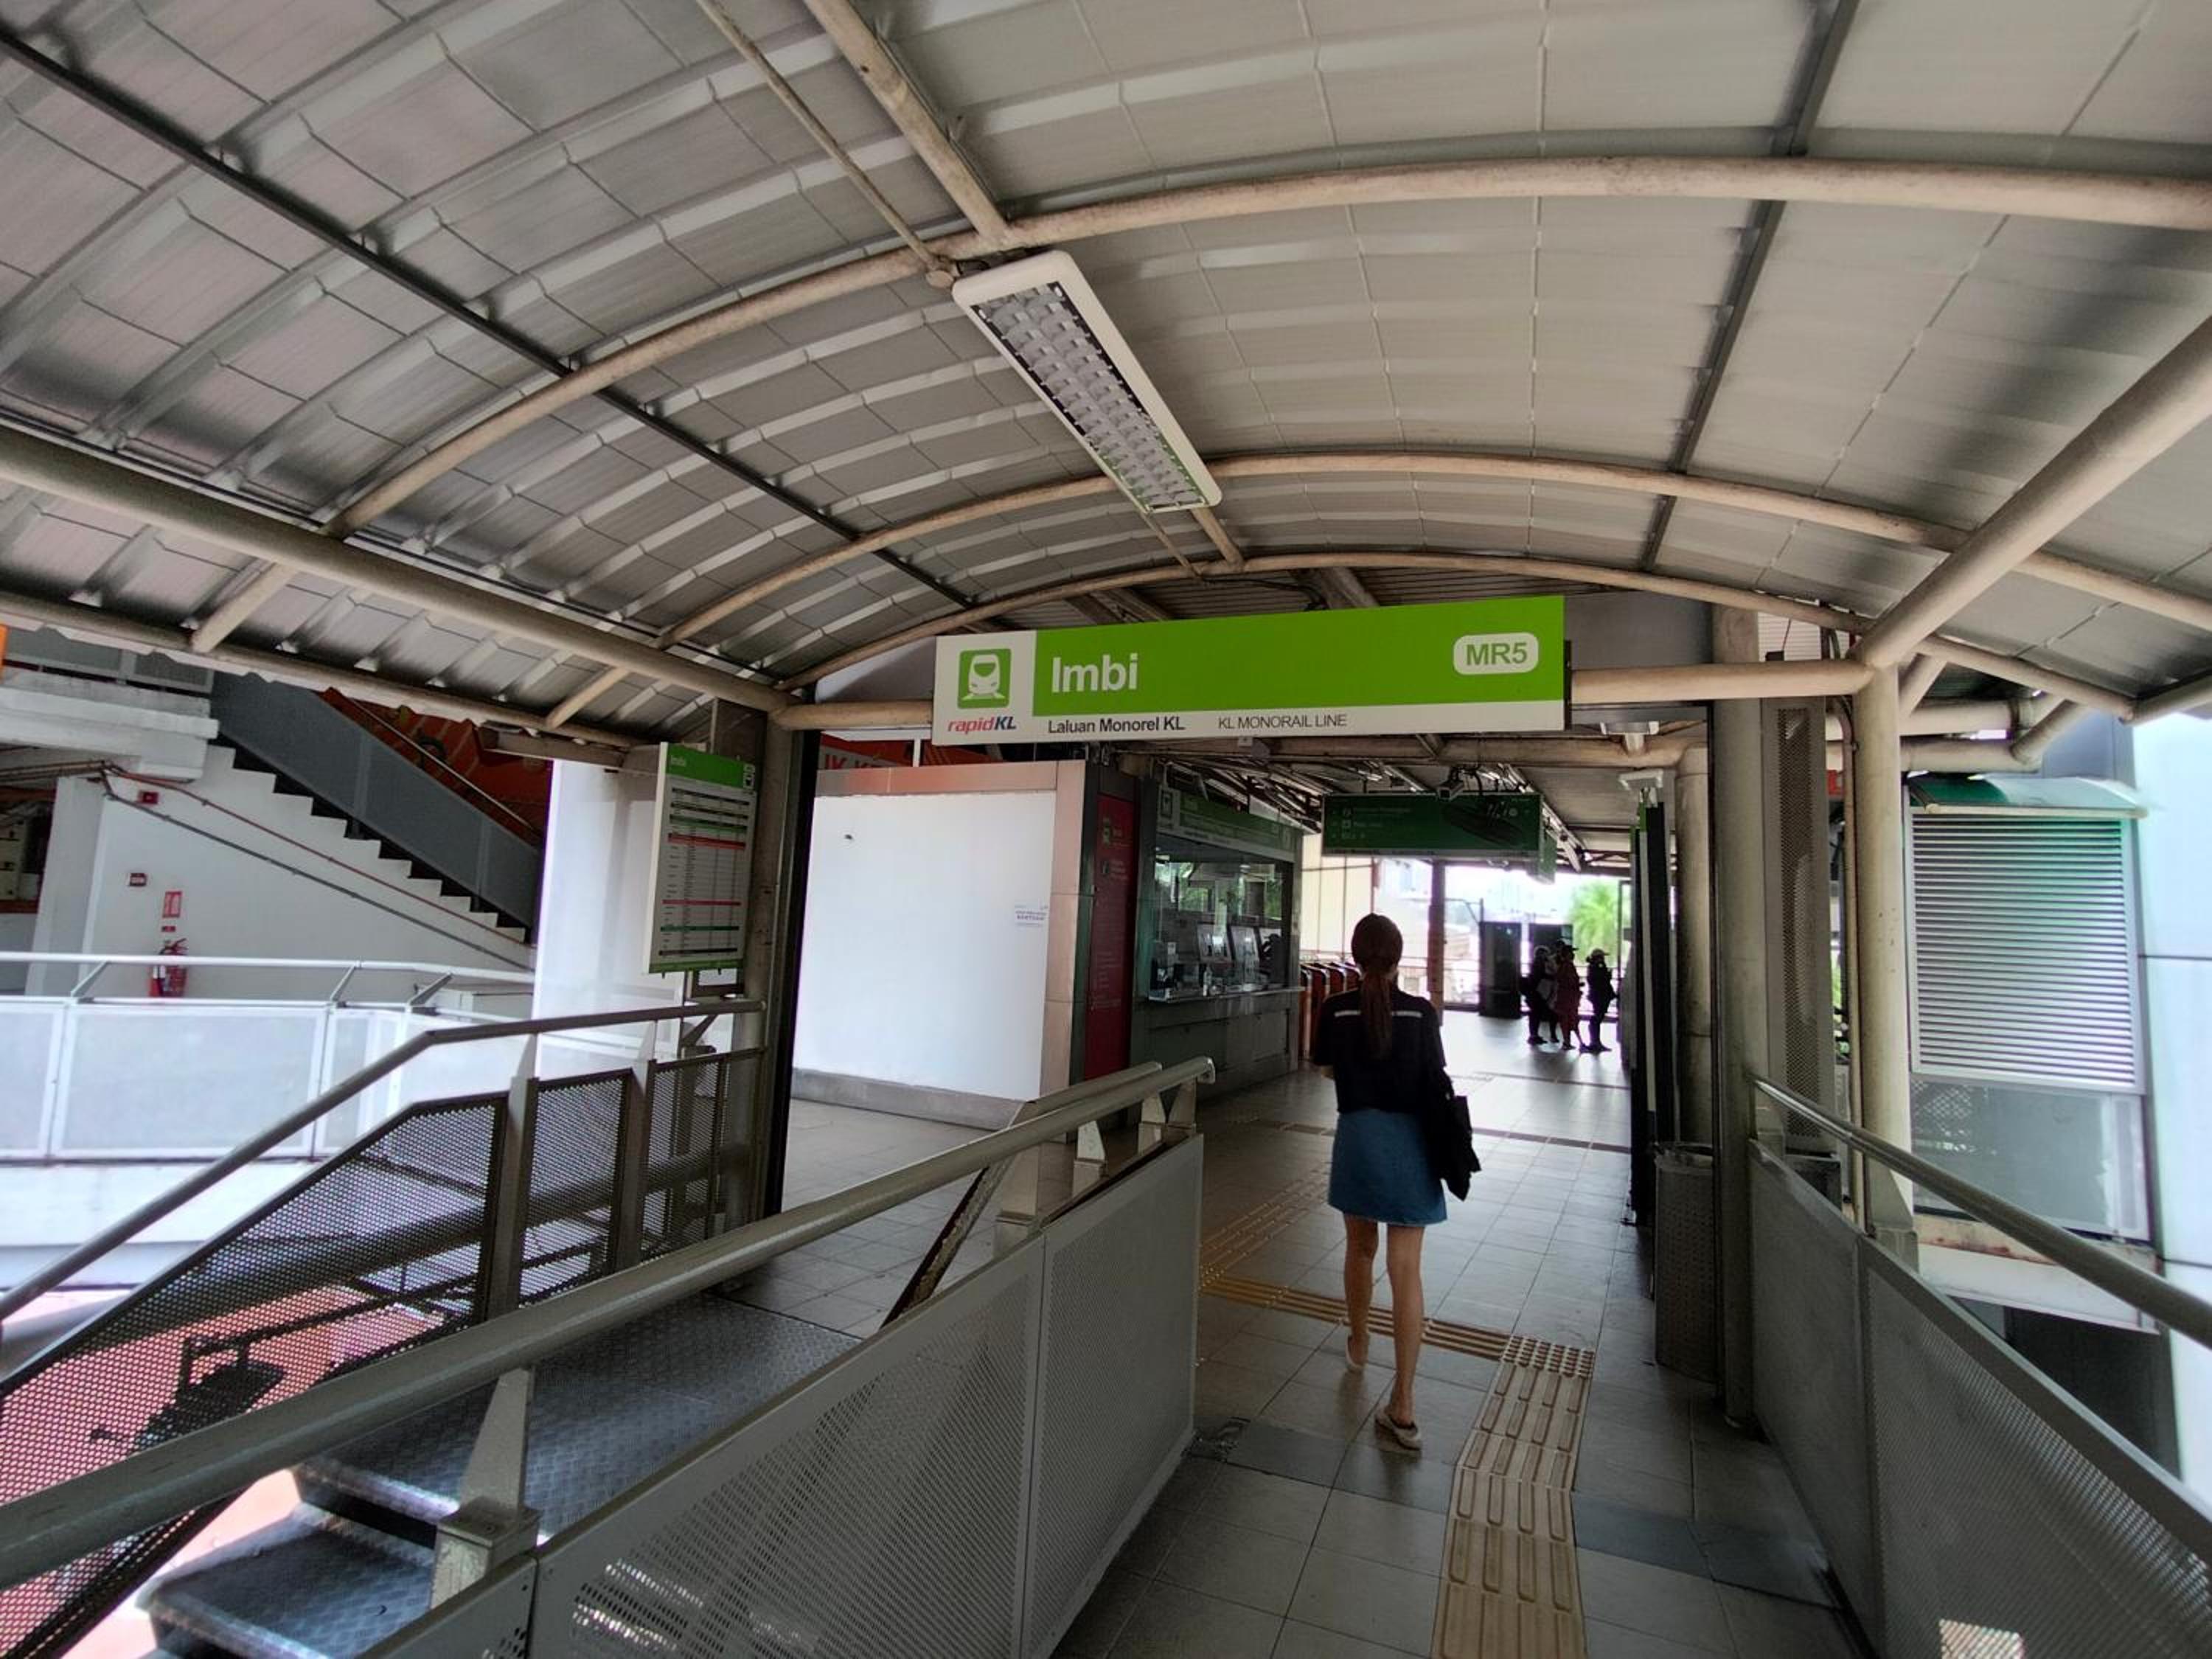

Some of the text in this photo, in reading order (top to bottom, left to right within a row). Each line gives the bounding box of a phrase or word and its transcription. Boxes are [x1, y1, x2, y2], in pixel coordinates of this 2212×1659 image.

[1466, 642, 1528, 665] MR5
[1051, 653, 1138, 692] Imbi
[947, 716, 1017, 734] rapidKL
[1048, 716, 1185, 734] Laluan Monorel KL
[1218, 714, 1347, 729] KL MONORAIL LINE
